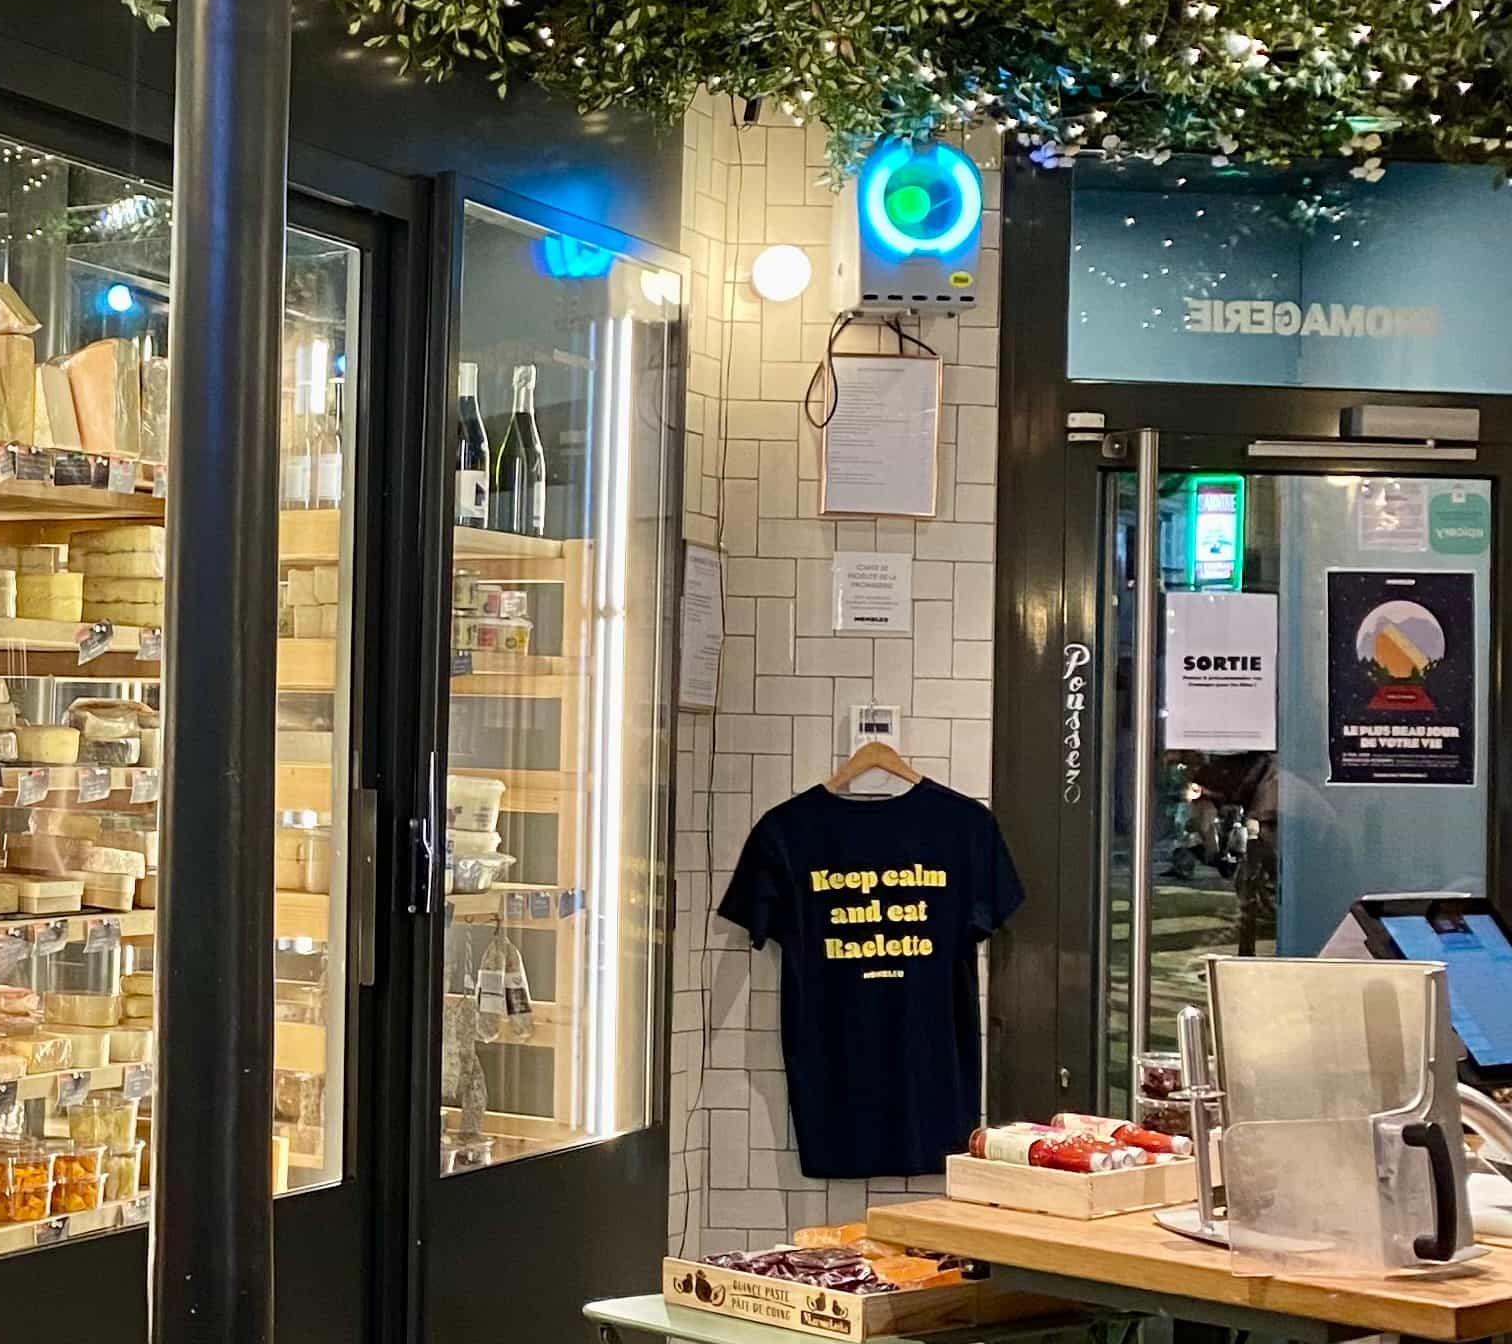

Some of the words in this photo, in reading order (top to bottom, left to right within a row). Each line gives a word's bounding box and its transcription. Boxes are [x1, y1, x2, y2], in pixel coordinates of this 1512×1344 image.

[1183, 656, 1262, 671] SORTIE
[1063, 643, 1091, 804] Poussez
[1343, 725, 1359, 736] LE
[1360, 725, 1392, 737] PLUS
[1426, 725, 1461, 738] JOUR
[810, 869, 878, 894] Keep
[881, 863, 947, 887] calm
[830, 899, 882, 924] and
[887, 900, 928, 922] eat
[824, 934, 933, 959] Raclette
[765, 1285, 791, 1302] PASTE
